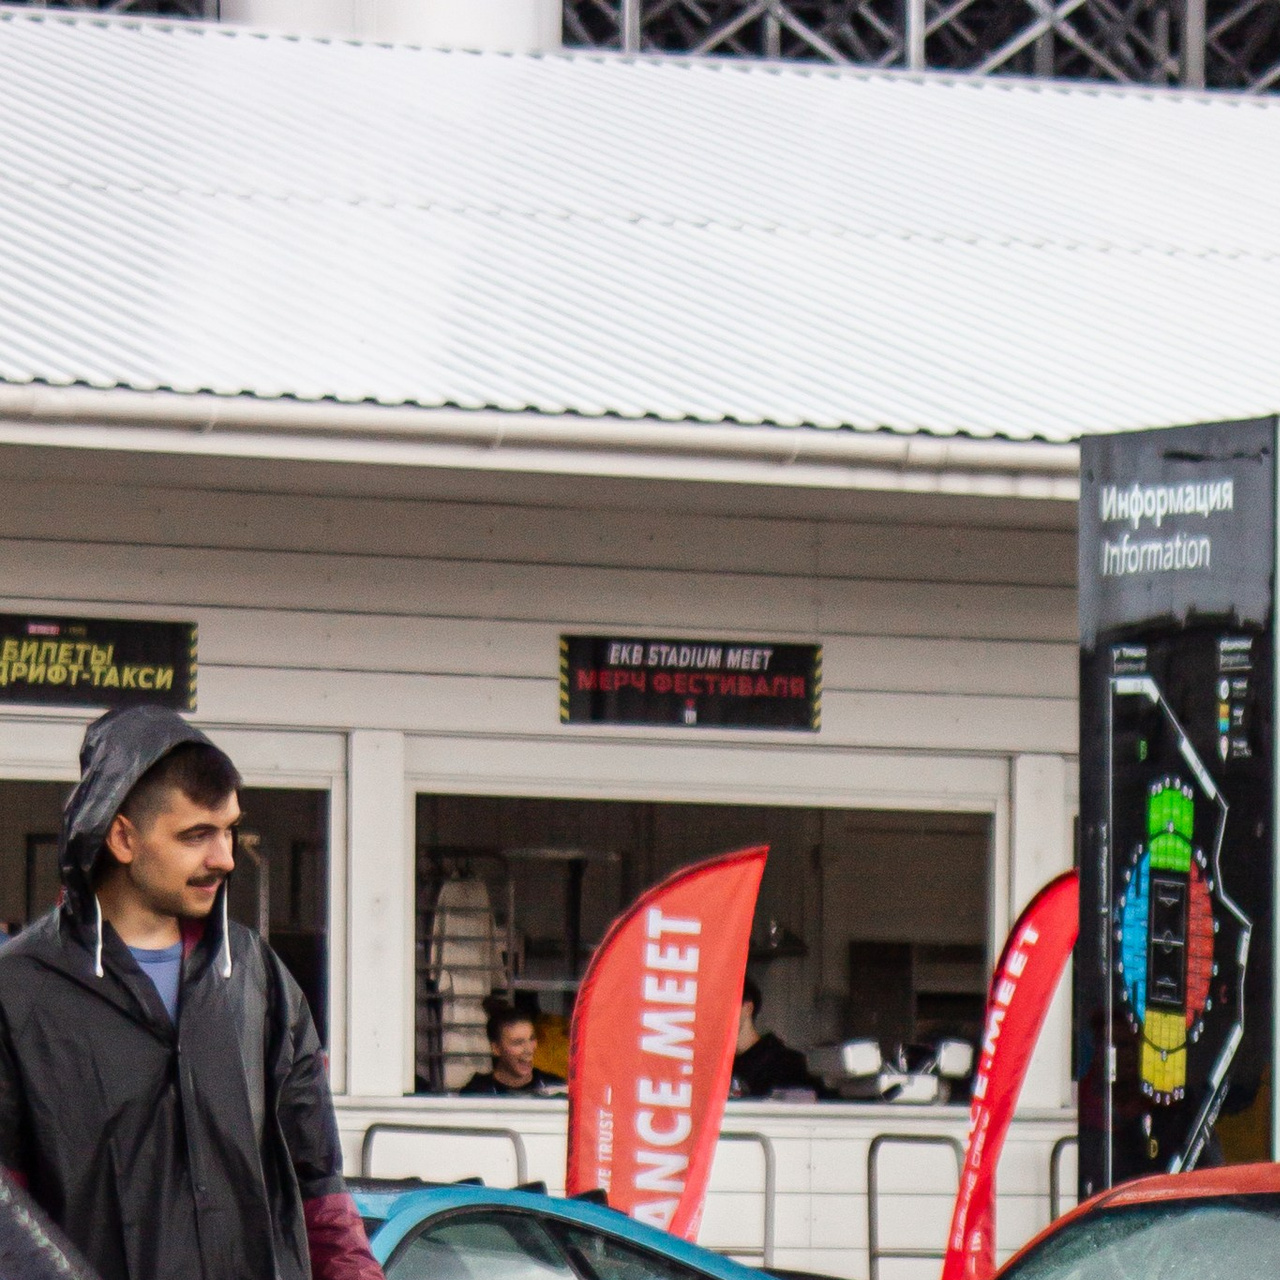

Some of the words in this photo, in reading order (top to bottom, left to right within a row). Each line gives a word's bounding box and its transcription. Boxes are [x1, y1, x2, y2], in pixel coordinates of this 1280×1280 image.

[1102, 480, 1234, 530] Информация
[1103, 533, 1211, 577] Information
[2, 639, 115, 667] БИЛЕТЫ
[609, 643, 643, 666] EKB
[648, 646, 722, 669] STADIUM
[727, 649, 774, 671] MEET
[576, 669, 647, 694] МЕРЧ
[652, 671, 806, 699] ФЕСТИВАЛЯ
[634, 906, 702, 1232] ANCE.MEET
[598, 1109, 613, 1163] TRUST
